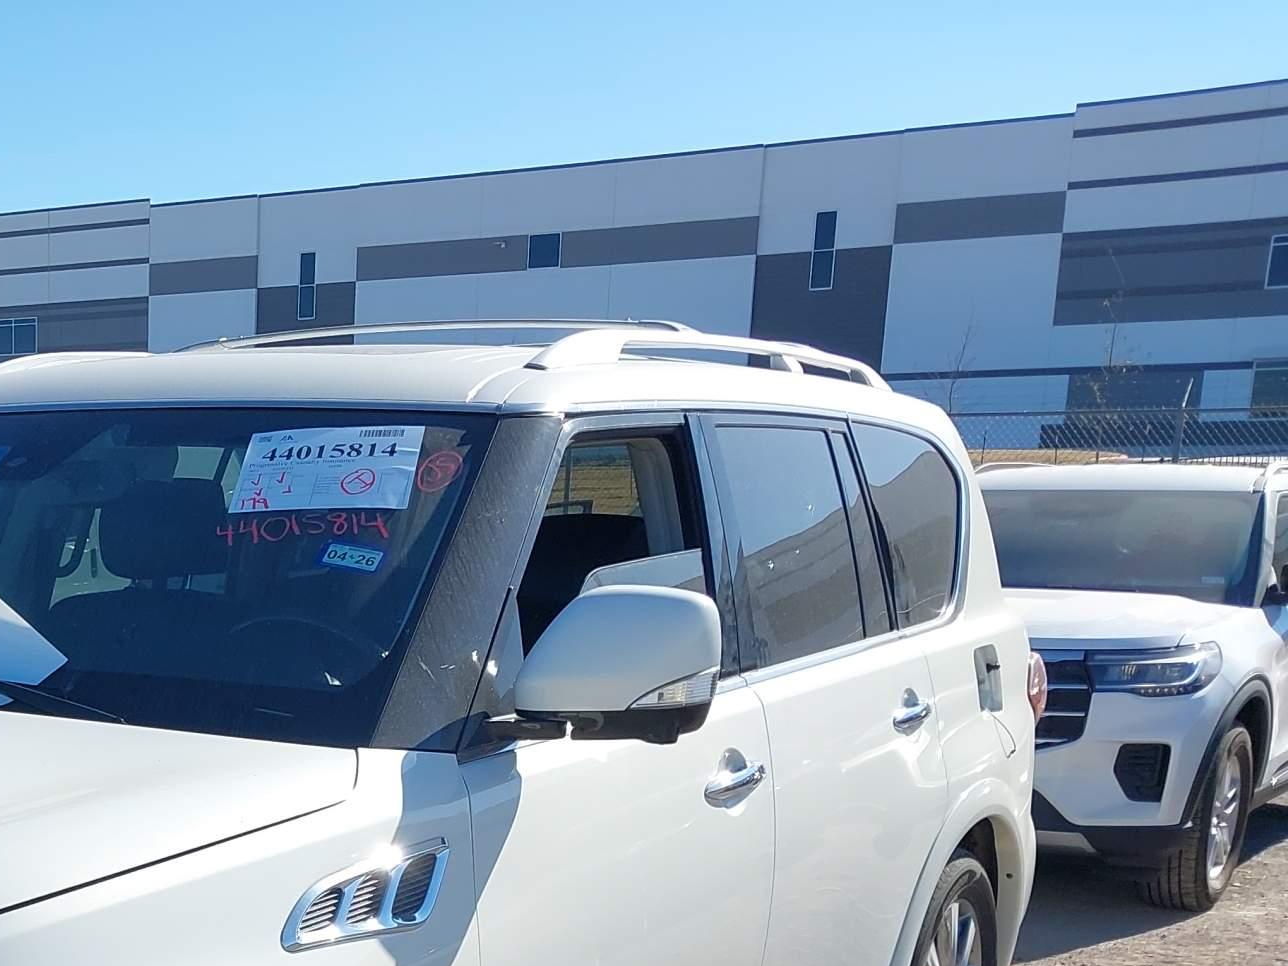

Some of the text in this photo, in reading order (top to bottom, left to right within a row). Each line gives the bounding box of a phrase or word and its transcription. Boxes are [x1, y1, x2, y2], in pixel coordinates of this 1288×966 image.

[262, 442, 397, 461] 44015814
[216, 511, 389, 546] 44015814
[355, 554, 376, 567] 26
